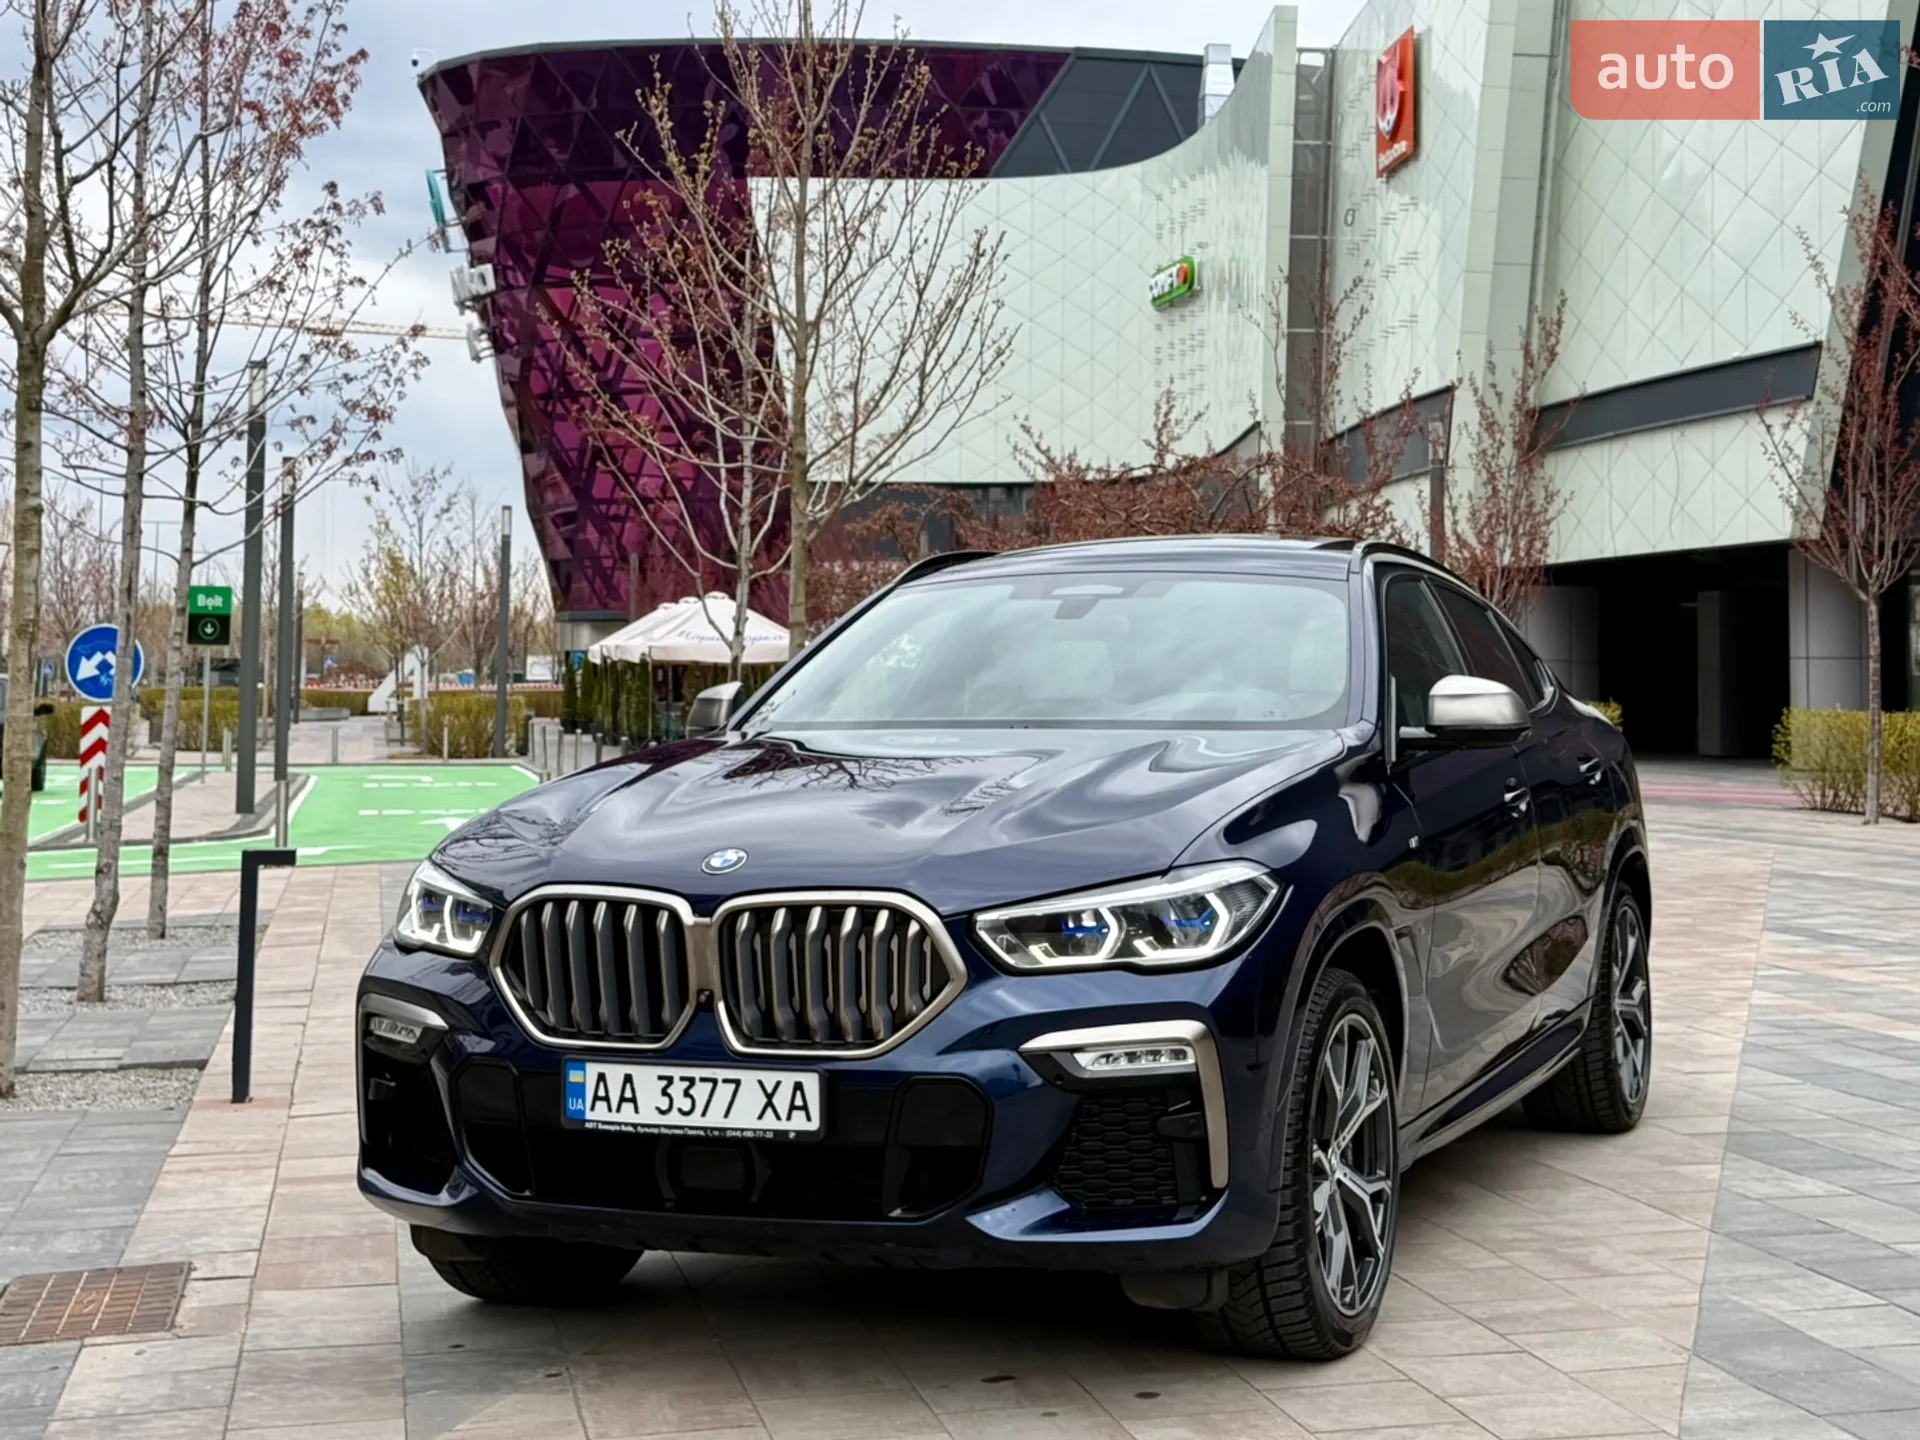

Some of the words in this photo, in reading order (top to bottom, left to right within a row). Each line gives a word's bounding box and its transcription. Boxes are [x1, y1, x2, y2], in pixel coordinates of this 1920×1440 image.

[197, 593, 223, 610] Bolt
[569, 1098, 584, 1111] UA
[590, 1072, 639, 1114] AA
[655, 1075, 742, 1119] 3377
[757, 1079, 812, 1122] XA
